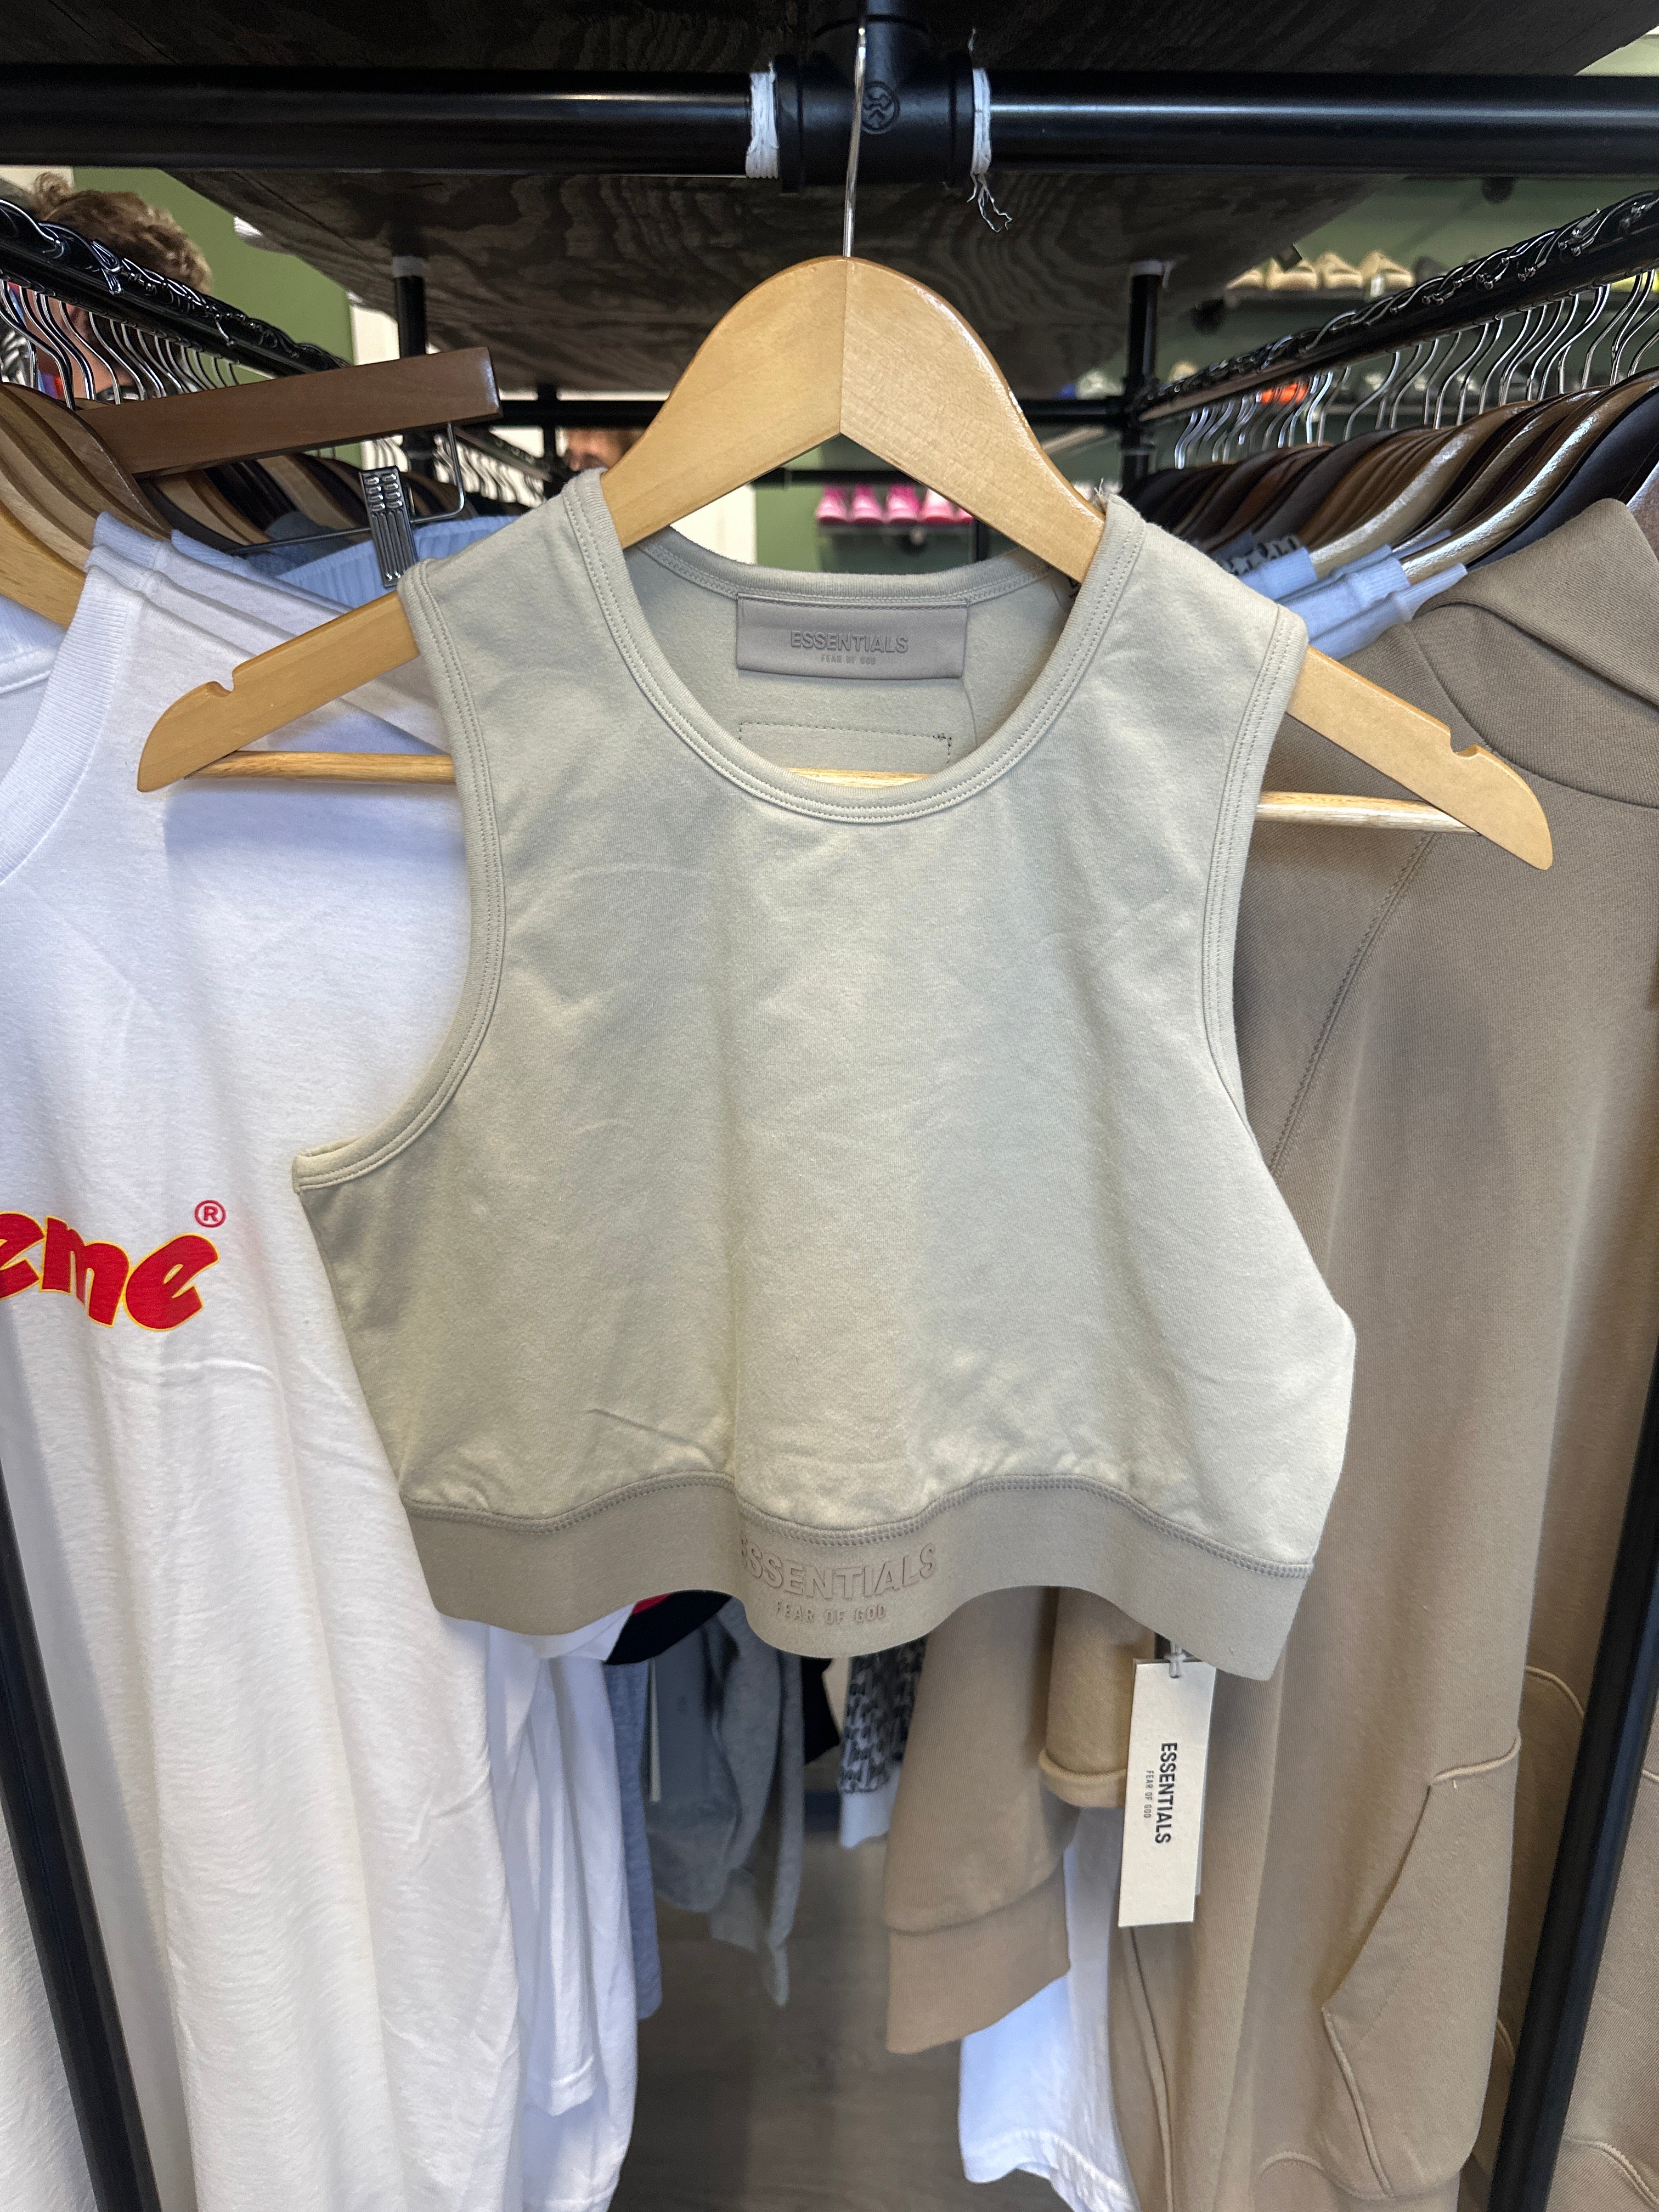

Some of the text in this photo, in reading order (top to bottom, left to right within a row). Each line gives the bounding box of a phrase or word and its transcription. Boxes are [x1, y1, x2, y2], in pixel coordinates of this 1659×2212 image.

[791, 630, 909, 653] ESSENTIALS
[776, 1601, 887, 1626] FEAR OF GOD
[1143, 1770, 1154, 1818] FEAR OF GOD
[1154, 1742, 1178, 1844] ESSENTIALS
